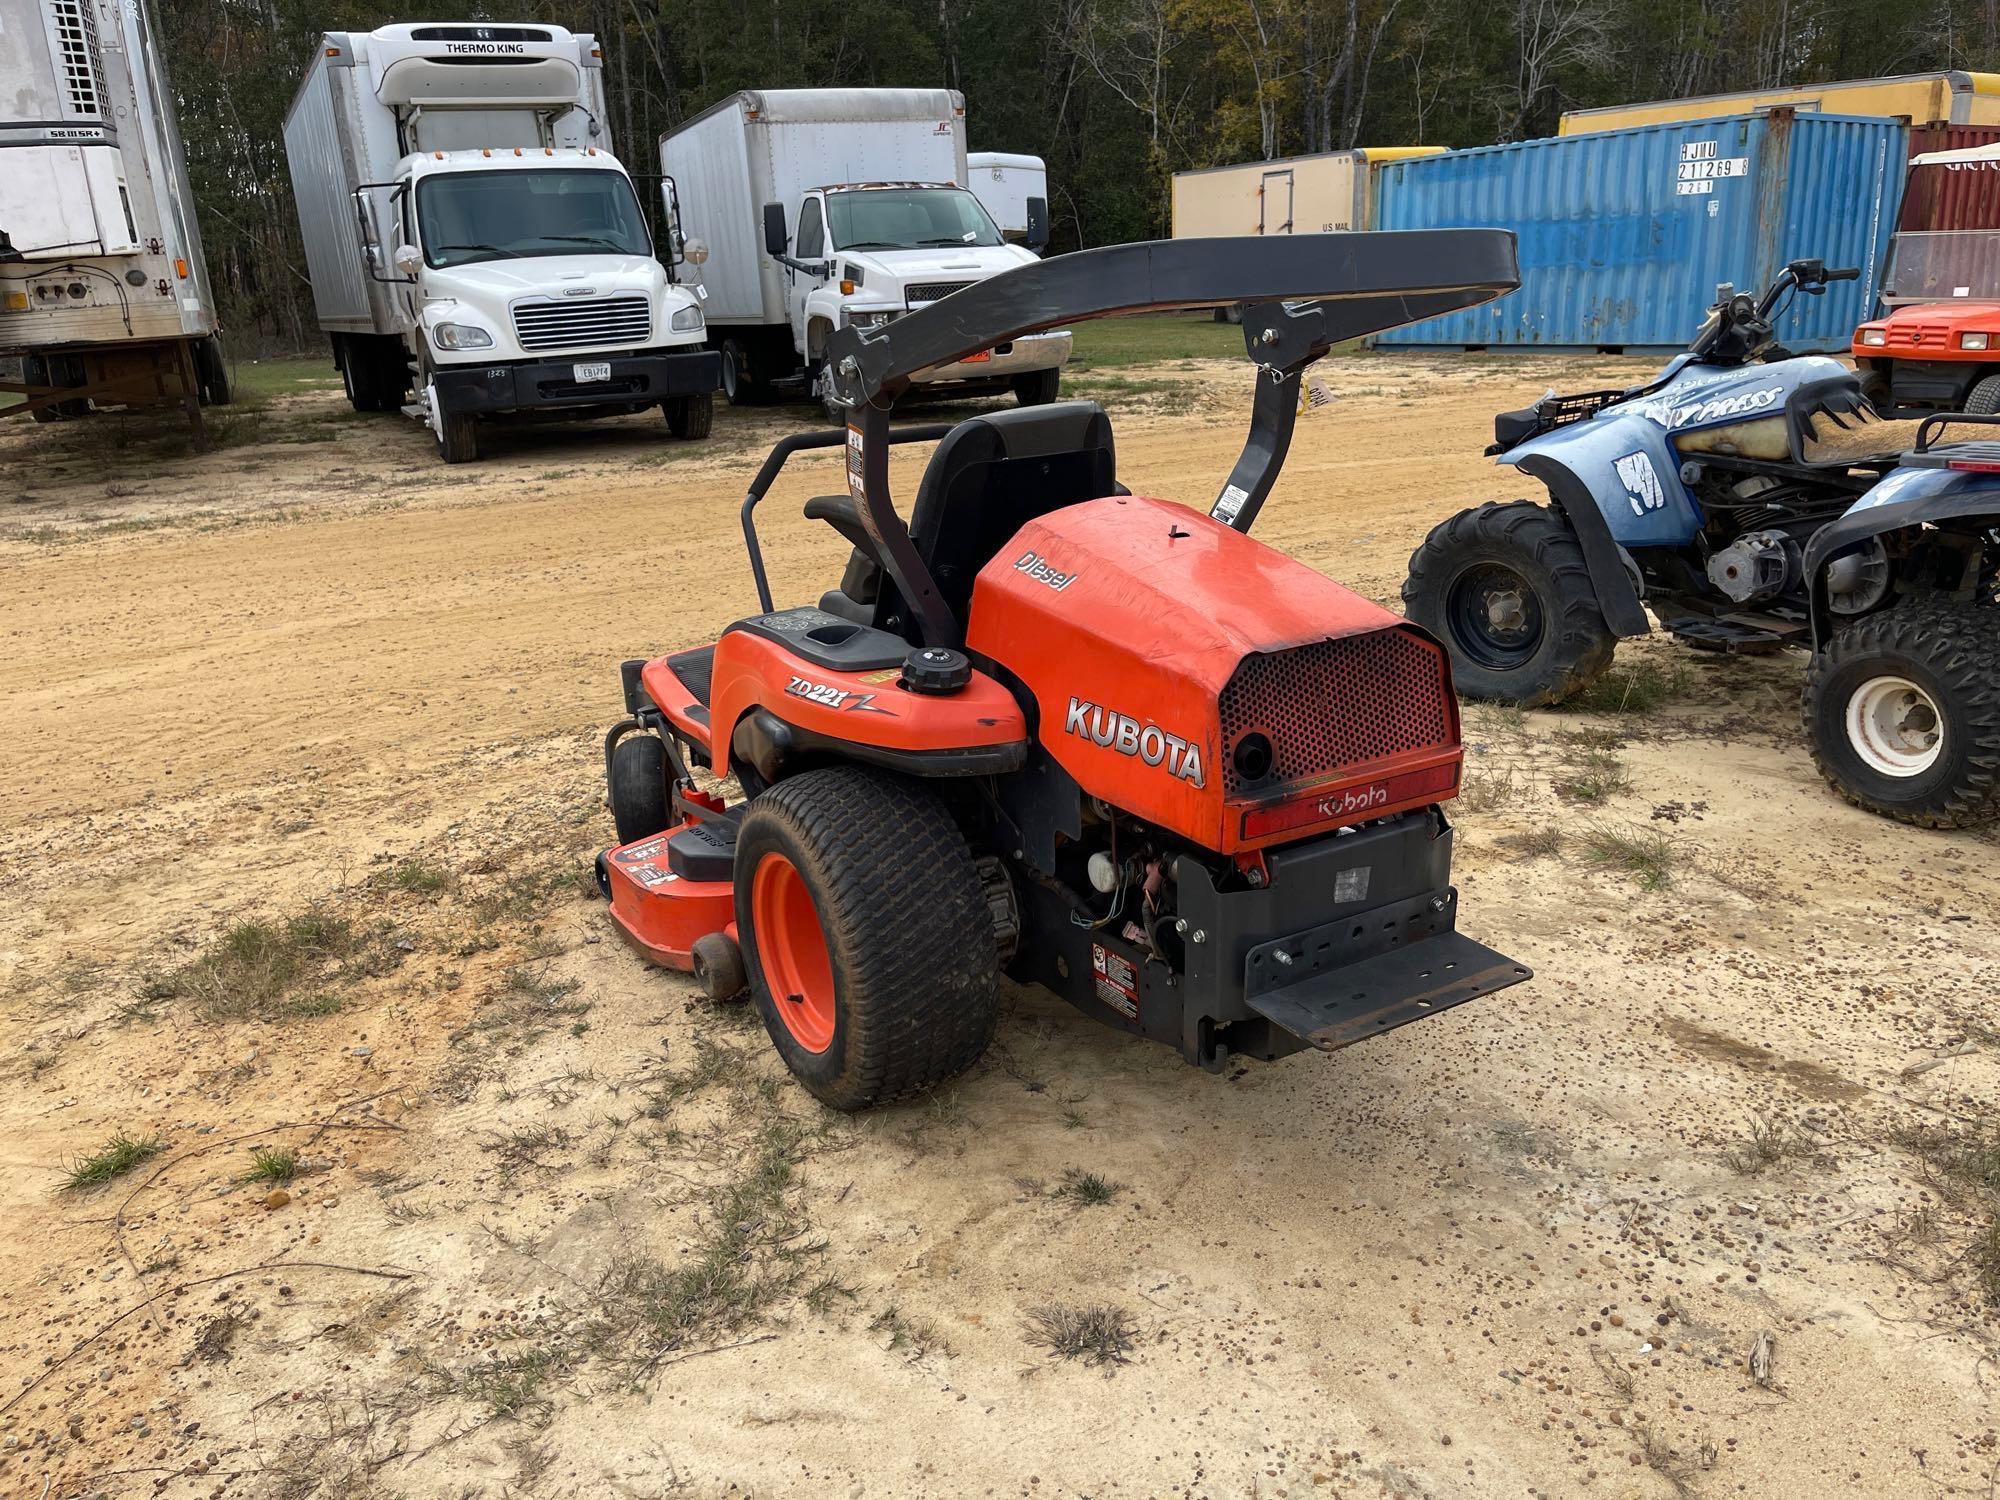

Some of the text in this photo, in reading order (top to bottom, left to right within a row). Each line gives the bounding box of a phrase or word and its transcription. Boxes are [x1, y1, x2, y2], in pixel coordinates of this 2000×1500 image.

[446, 44, 524, 53] THERMO KING
[1013, 549, 1078, 592] Diesel
[785, 675, 851, 708] ZD221
[1065, 696, 1206, 790] KUBOTA
[1318, 785, 1387, 816] Kubota
